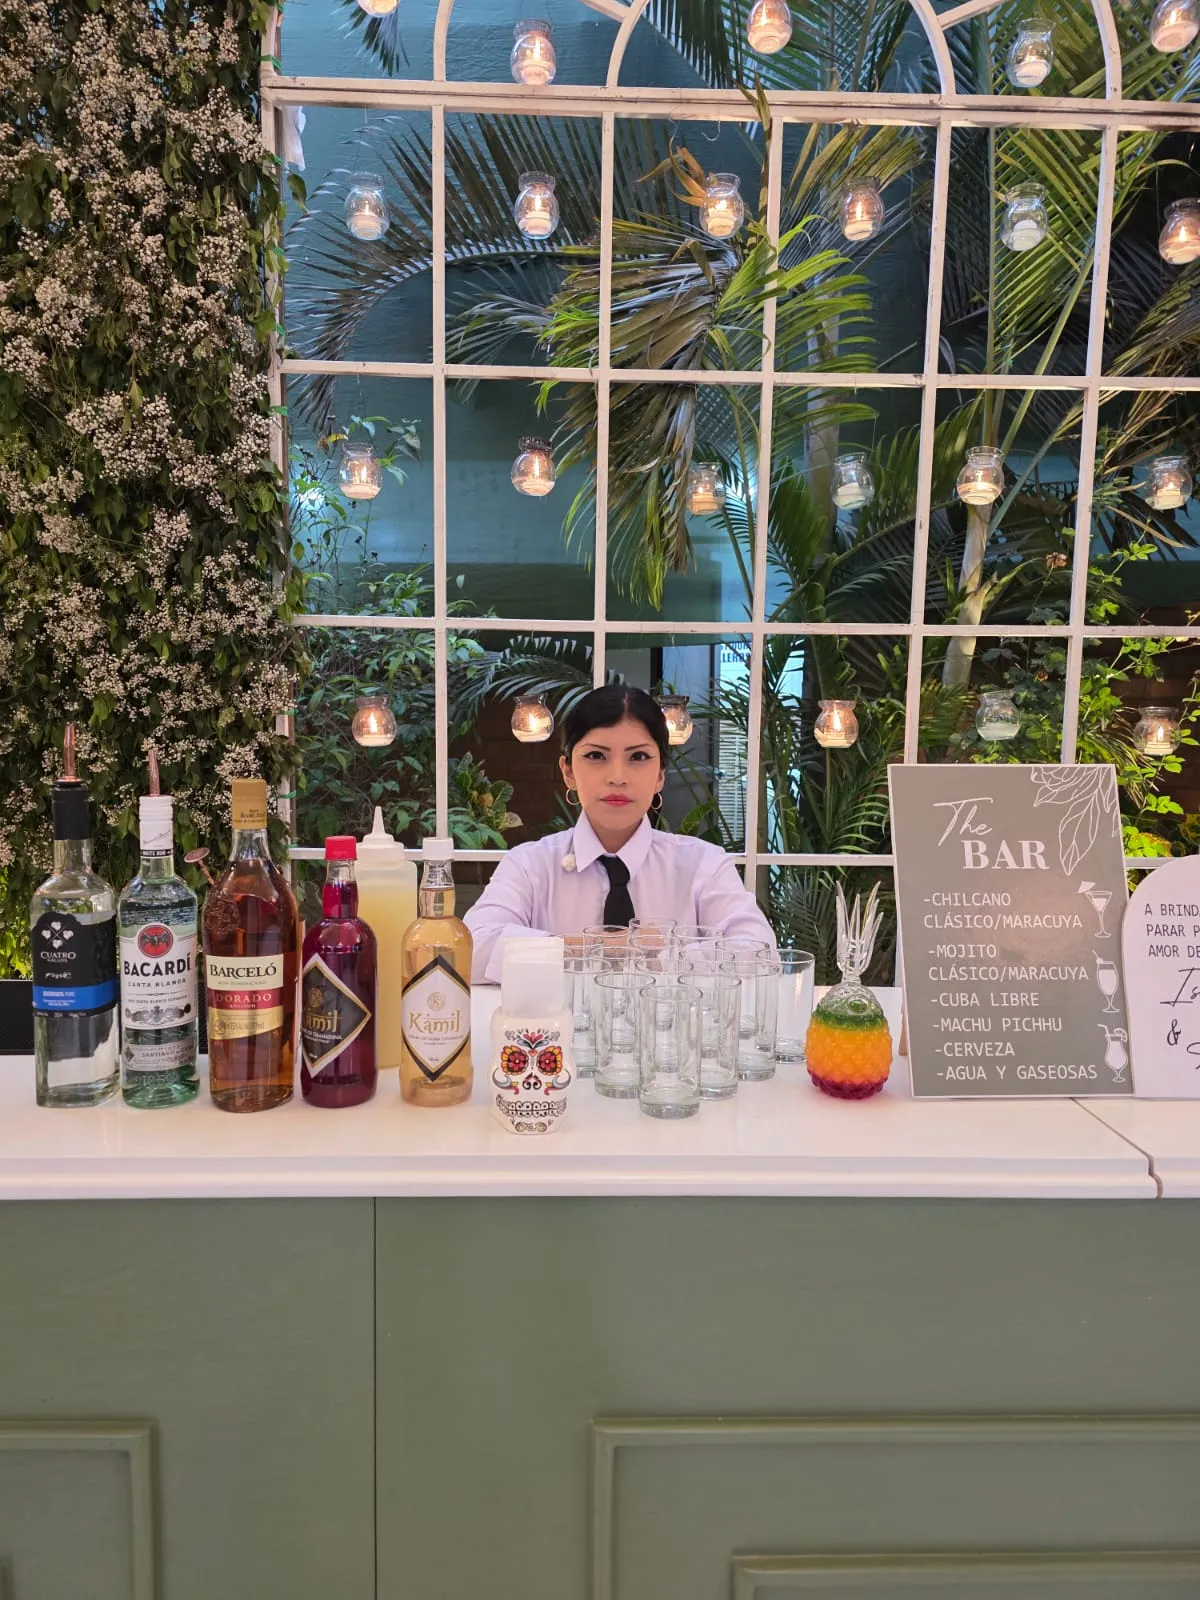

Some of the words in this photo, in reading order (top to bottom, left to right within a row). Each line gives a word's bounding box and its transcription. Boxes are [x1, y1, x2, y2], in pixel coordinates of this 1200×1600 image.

[933, 797, 994, 847] The
[960, 839, 1050, 870] BAR
[923, 892, 1012, 907] -CHILCANO
[1144, 903, 1153, 916] A
[1160, 904, 1200, 917] BRIND
[923, 912, 1083, 931] CLÁSICO/MARACUYA
[1146, 923, 1186, 937] PARAR
[40, 951, 77, 960] CUATRO
[928, 944, 997, 959] -MOJITO
[1148, 944, 1180, 958] AMOR
[124, 952, 191, 977] BACARDÍ
[210, 962, 277, 979] BARCELÓ
[928, 963, 1089, 982] CLÁSICO/MARACUYA
[216, 993, 272, 1004] DORADO
[931, 992, 980, 1007] -CUBA
[990, 992, 1040, 1007] LIBRE
[932, 1017, 992, 1032] -MACHU
[1002, 1017, 1062, 1032] PICHHU
[1166, 1018, 1182, 1046] &
[935, 1042, 1015, 1057] -CERVEZA
[937, 1066, 987, 1080] -AGUA
[996, 1065, 1006, 1080] Y
[1016, 1065, 1098, 1080] GASEOSAS
